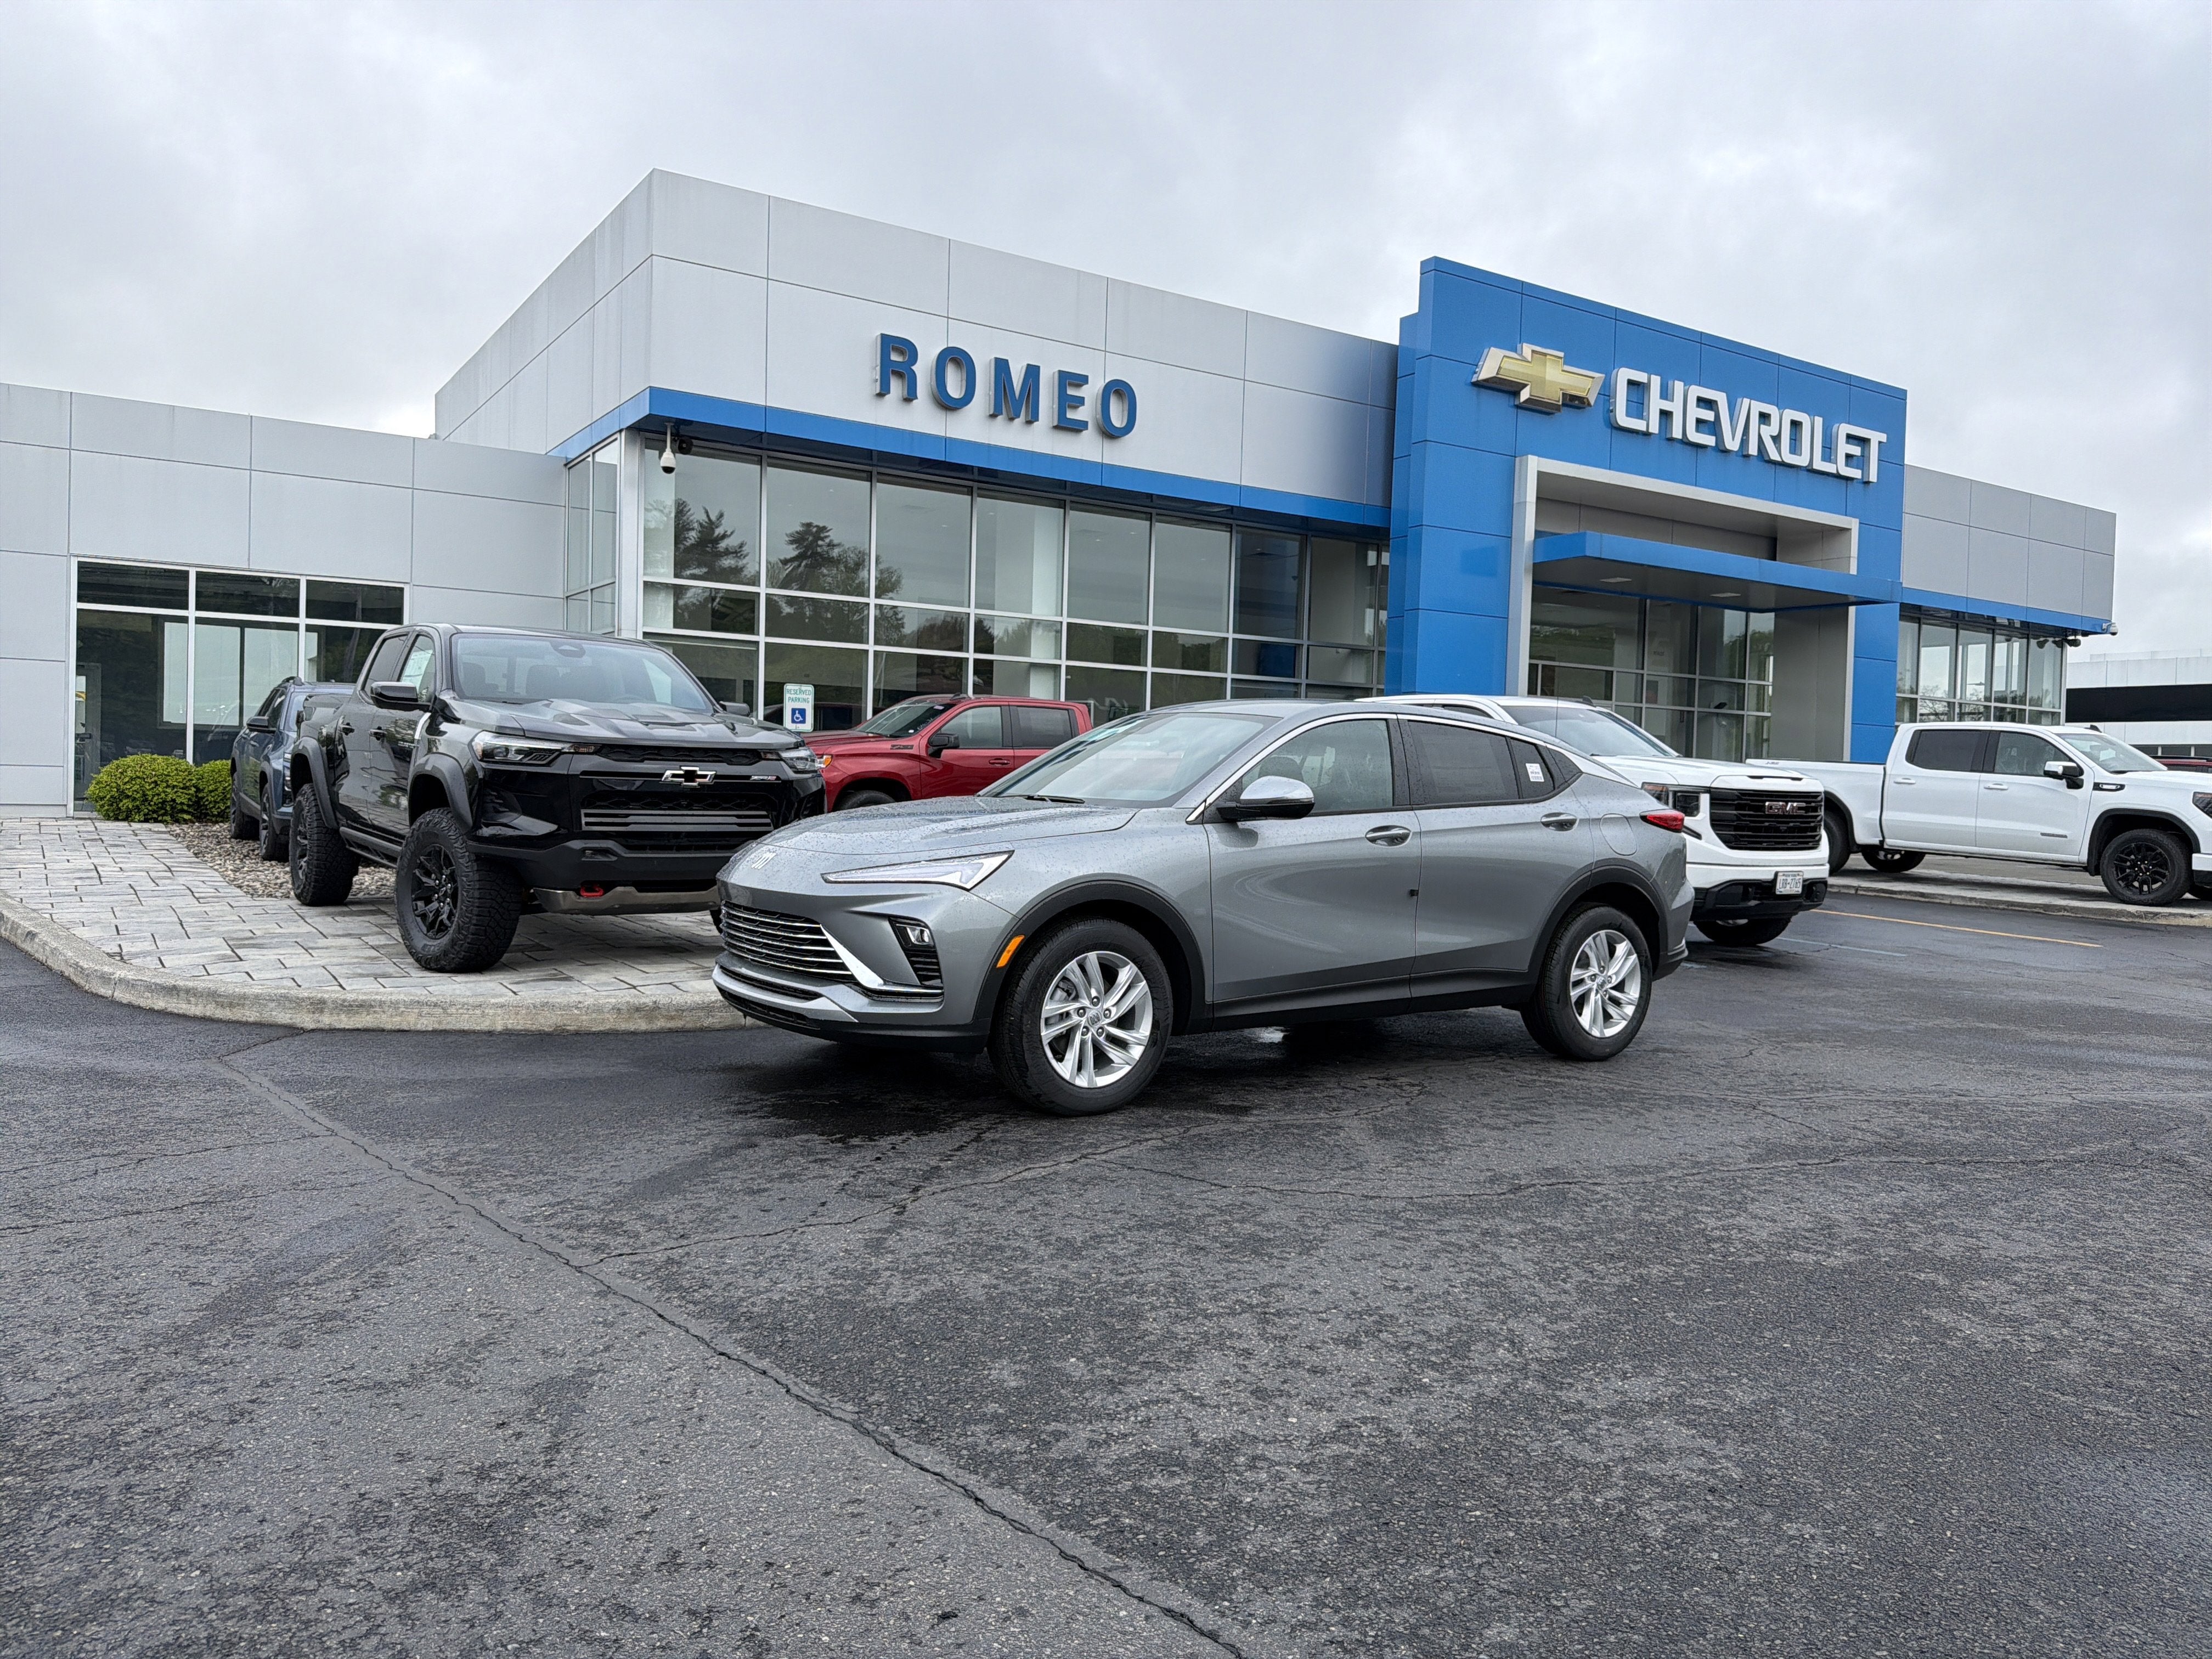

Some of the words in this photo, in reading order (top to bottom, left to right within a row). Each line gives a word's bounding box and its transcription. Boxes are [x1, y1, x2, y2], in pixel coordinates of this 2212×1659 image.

[876, 332, 1137, 438] ROMEO
[1610, 367, 1887, 483] CHEVROLET
[1765, 802, 1806, 815] GMC
